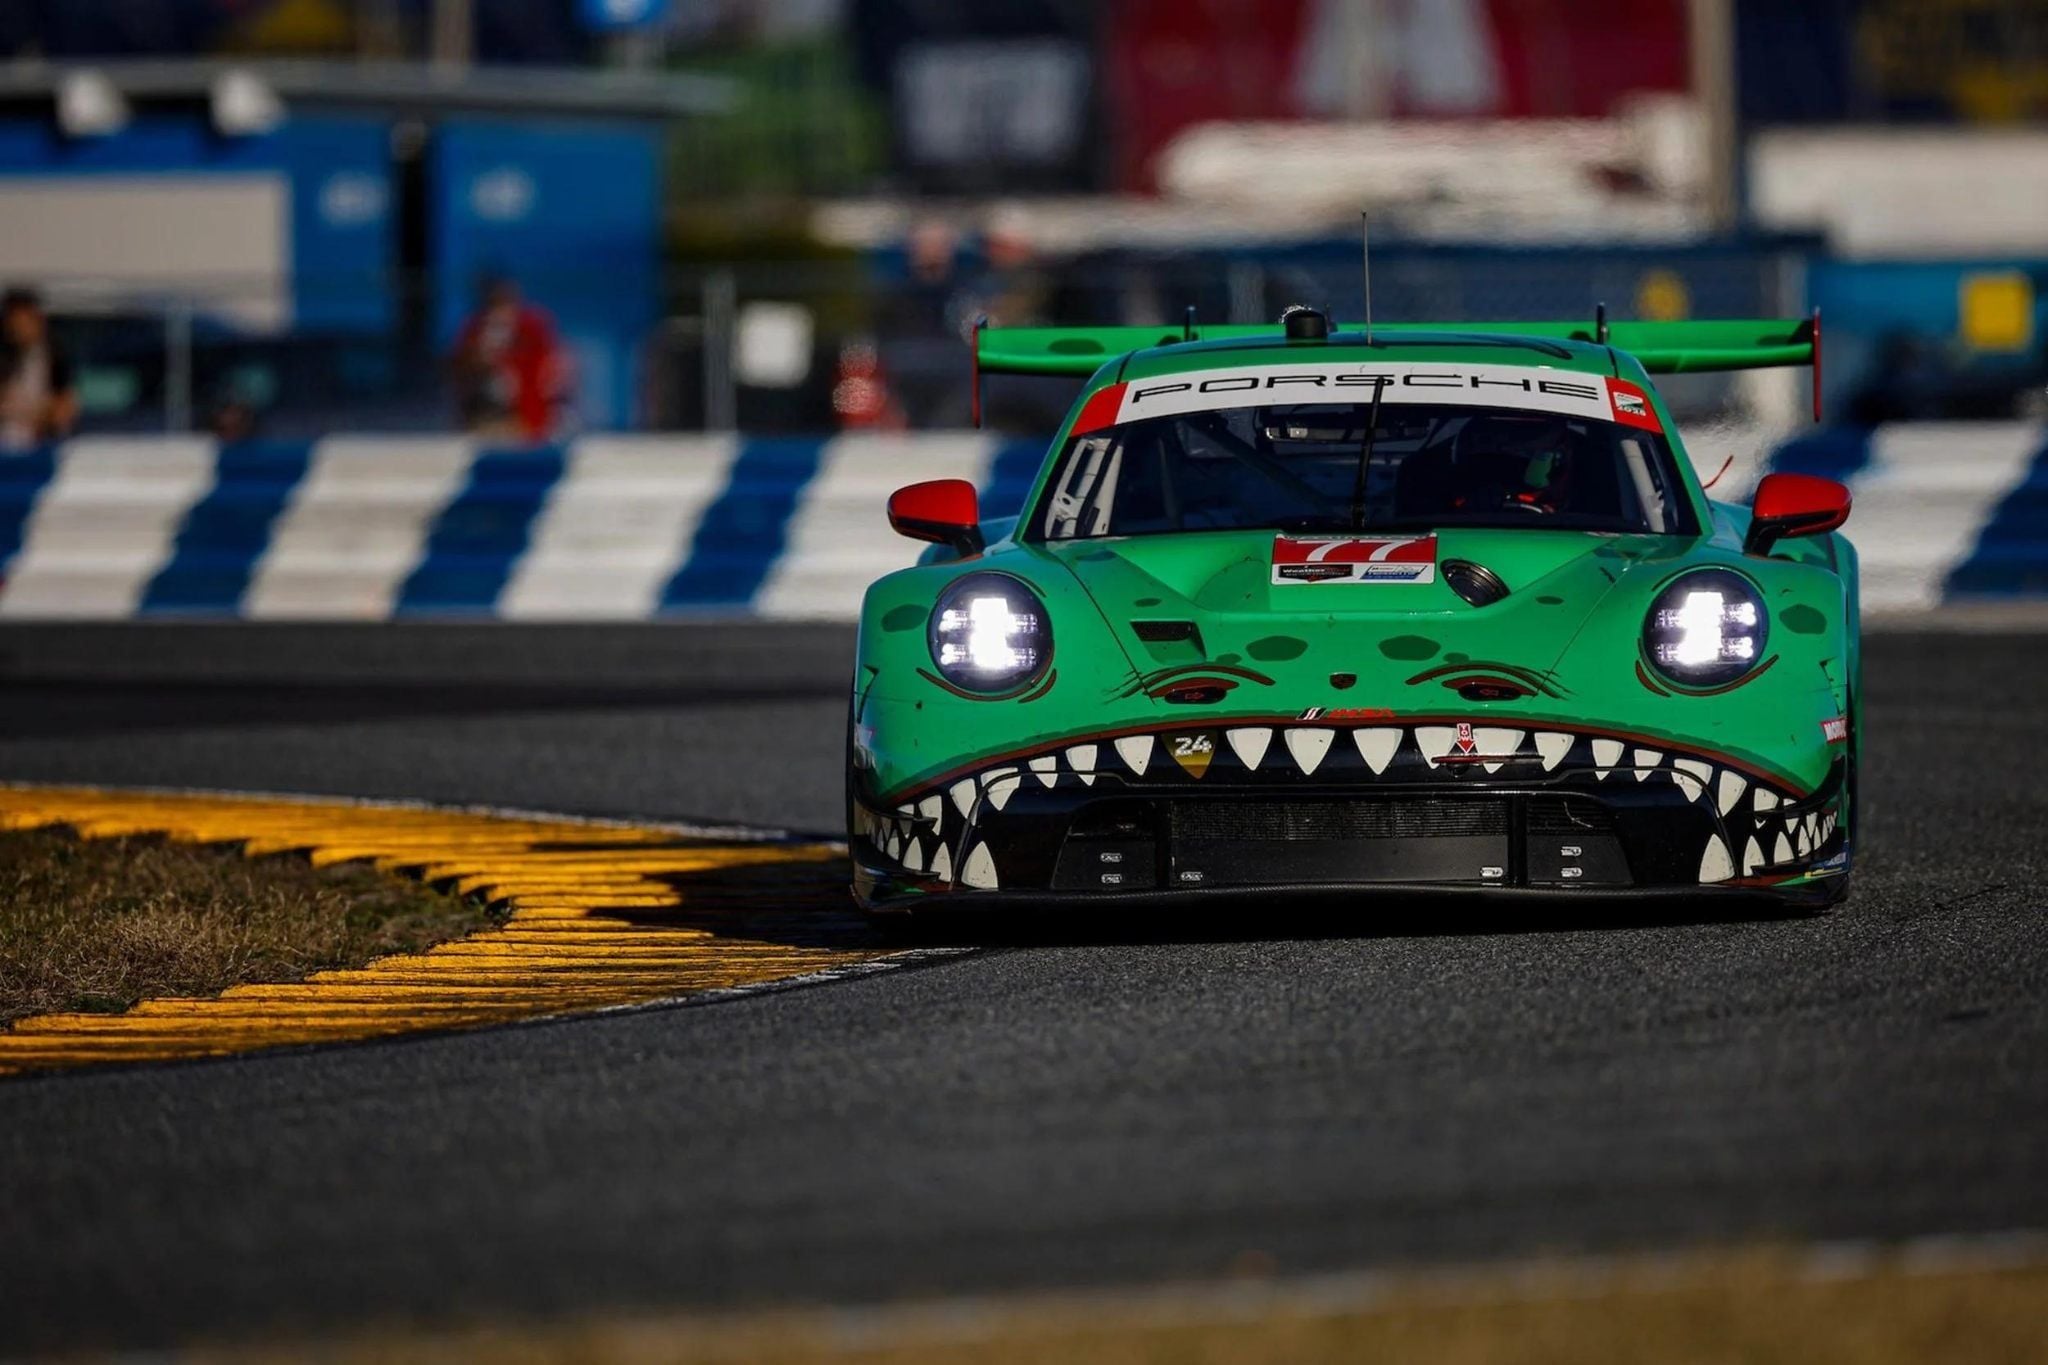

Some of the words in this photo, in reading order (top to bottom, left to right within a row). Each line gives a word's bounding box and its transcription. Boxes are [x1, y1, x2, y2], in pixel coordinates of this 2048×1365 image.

[1132, 374, 1599, 403] PORSCHE
[1296, 539, 1416, 562] 77
[1460, 725, 1470, 742] TOW
[1175, 735, 1212, 756] 24
